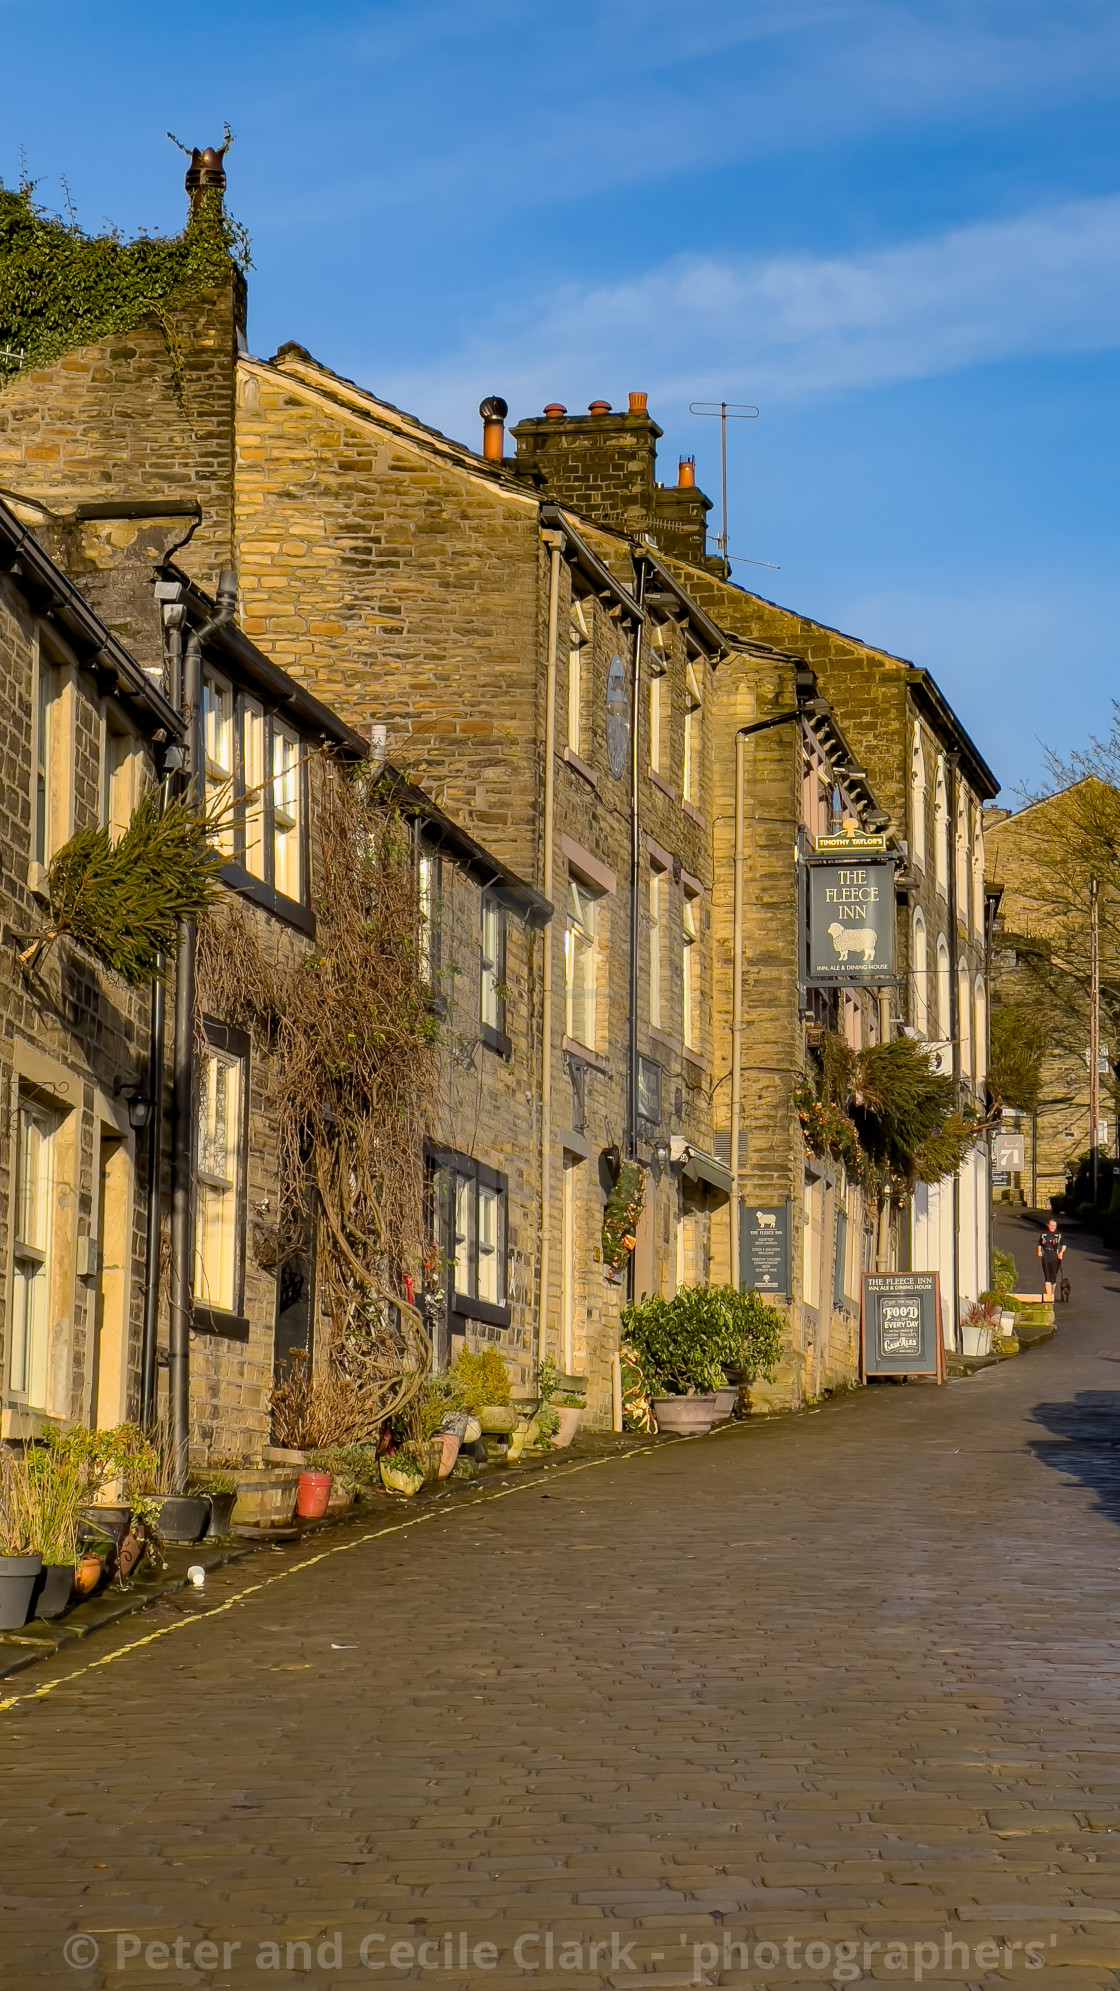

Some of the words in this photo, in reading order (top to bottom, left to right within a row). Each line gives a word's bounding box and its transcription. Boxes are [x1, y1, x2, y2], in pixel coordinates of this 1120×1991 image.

[838, 870, 867, 885] THE
[825, 888, 879, 903] FLEECE
[838, 905, 866, 920] INN
[1000, 1150, 1020, 1166] 71
[883, 1306, 918, 1321] FOOD
